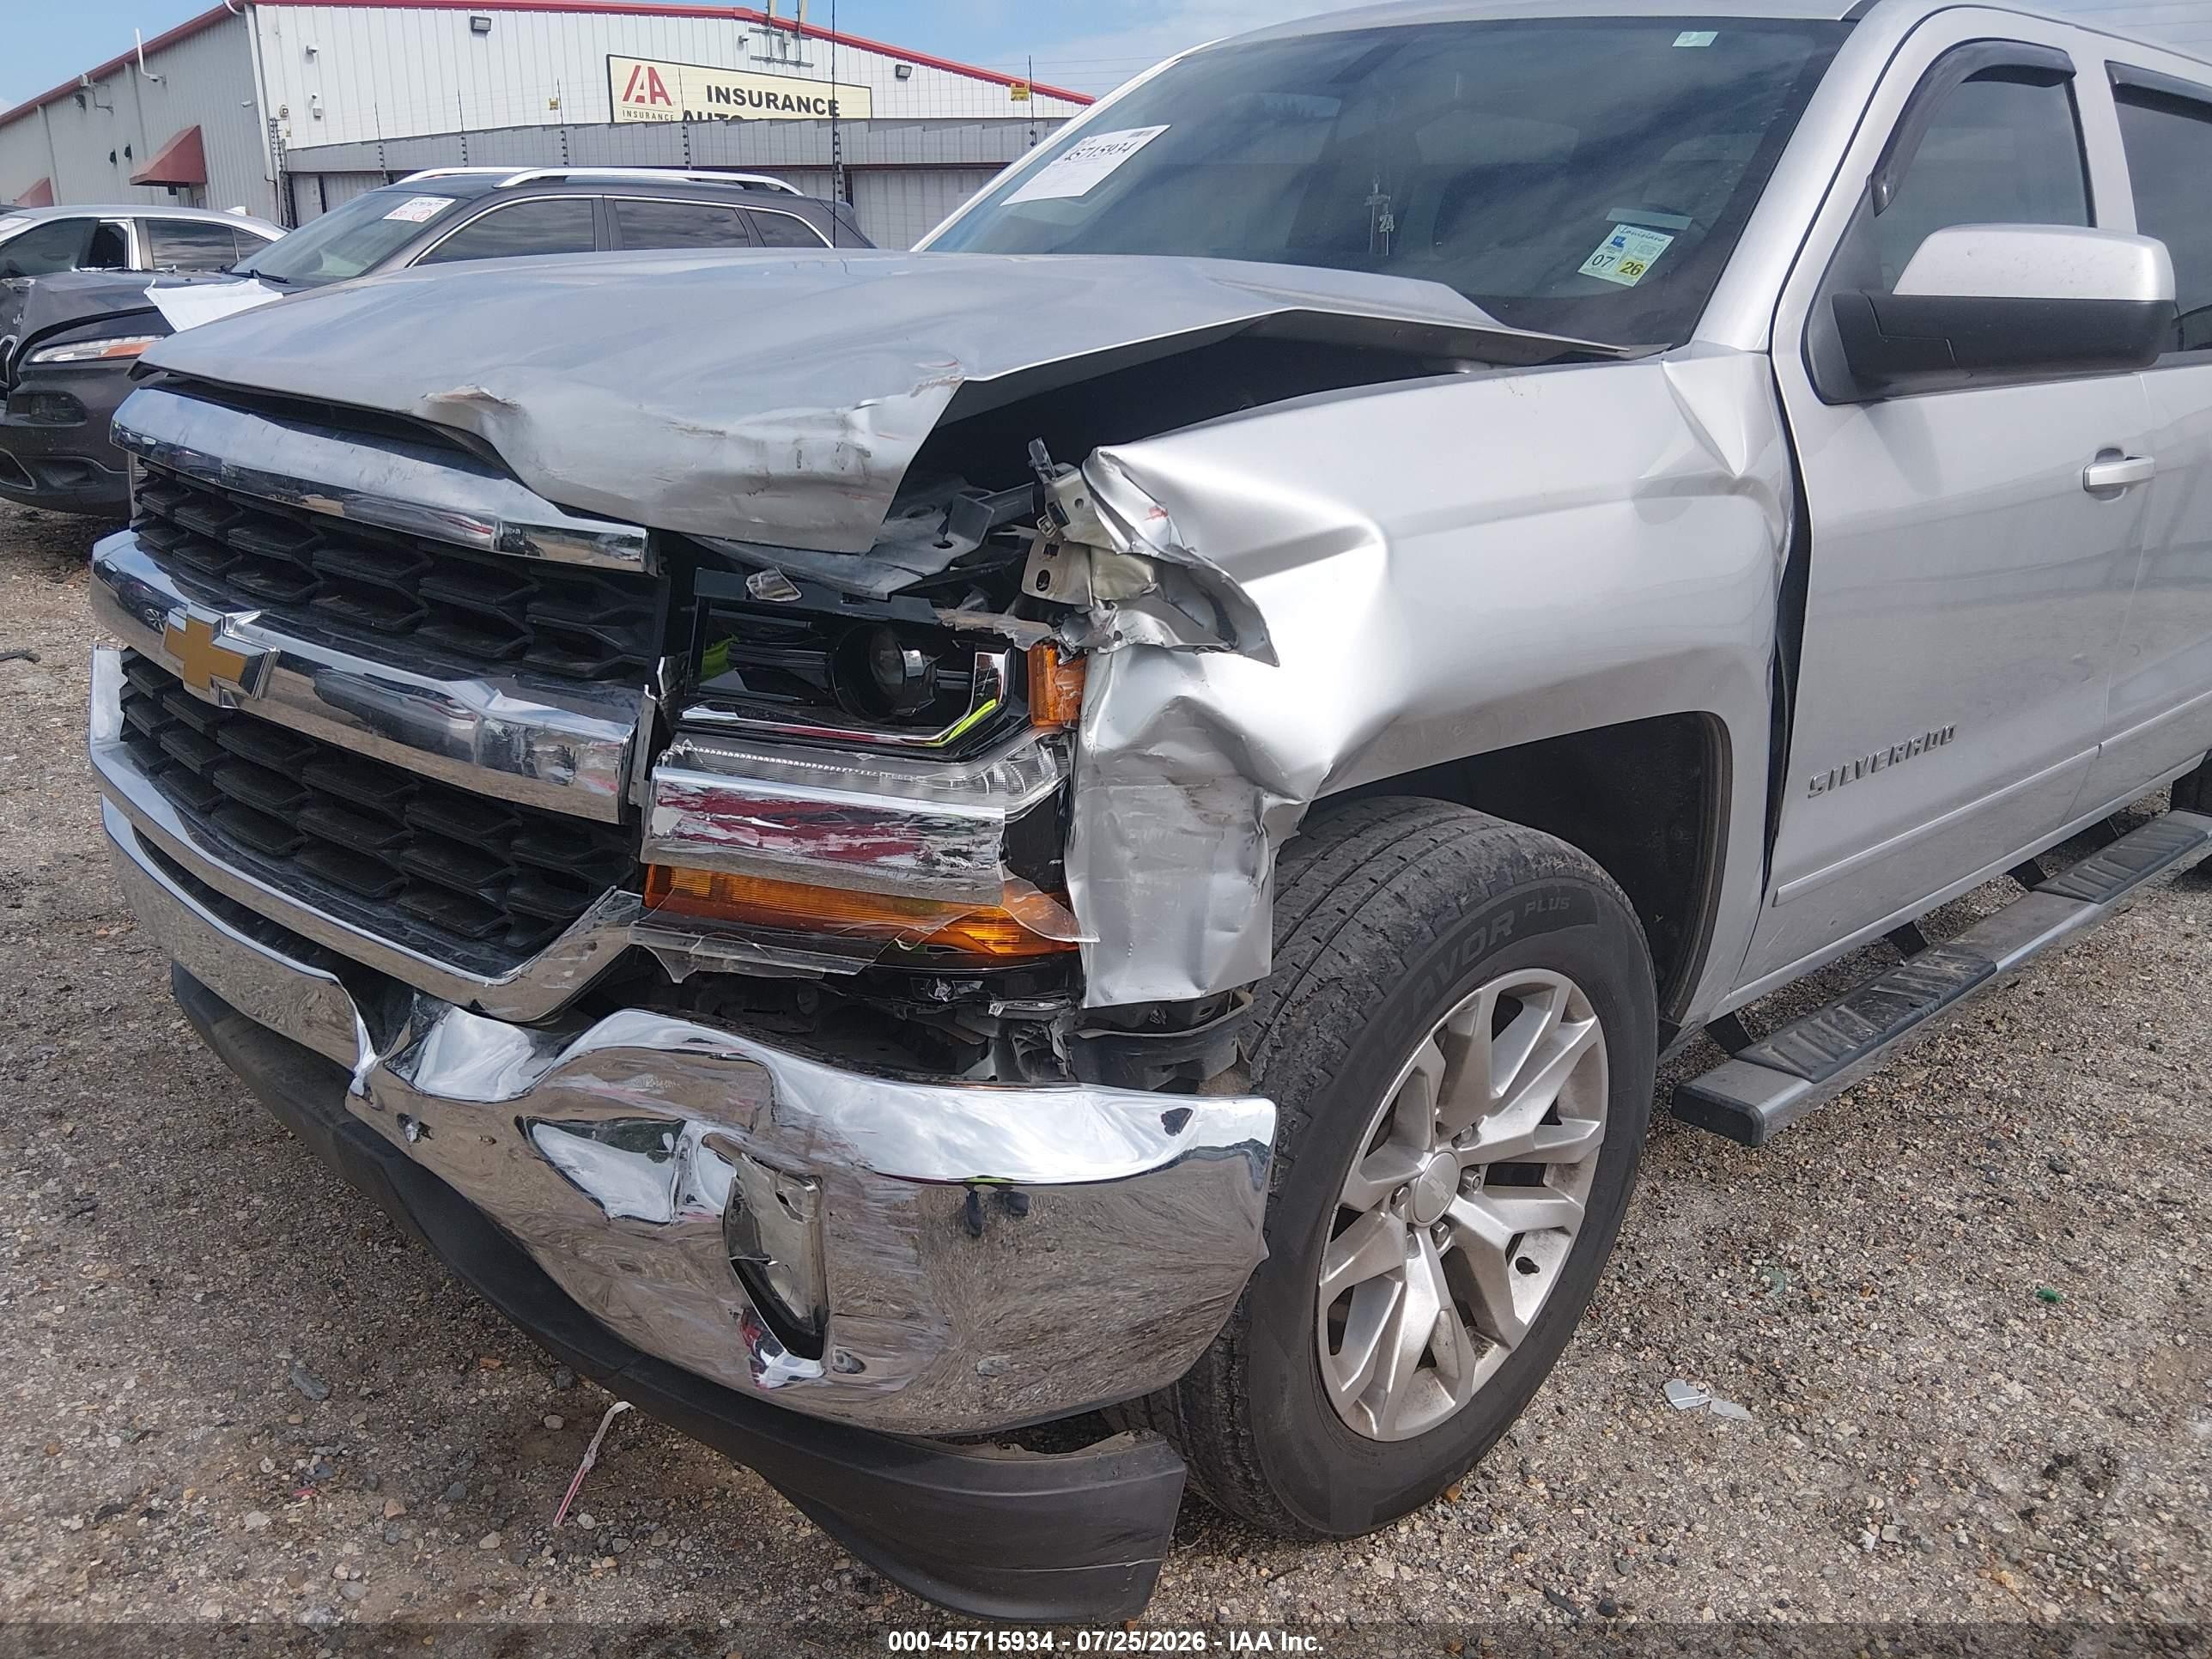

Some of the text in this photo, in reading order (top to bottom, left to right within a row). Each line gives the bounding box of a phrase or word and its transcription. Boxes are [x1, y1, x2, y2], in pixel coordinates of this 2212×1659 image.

[707, 84, 840, 118] INSURANCE
[623, 109, 674, 122] INSURANCE
[682, 110, 744, 121] AU
[1591, 254, 1644, 276] 07 26
[1808, 722, 1957, 799] SILVERADO
[1524, 896, 1571, 917] PLUS
